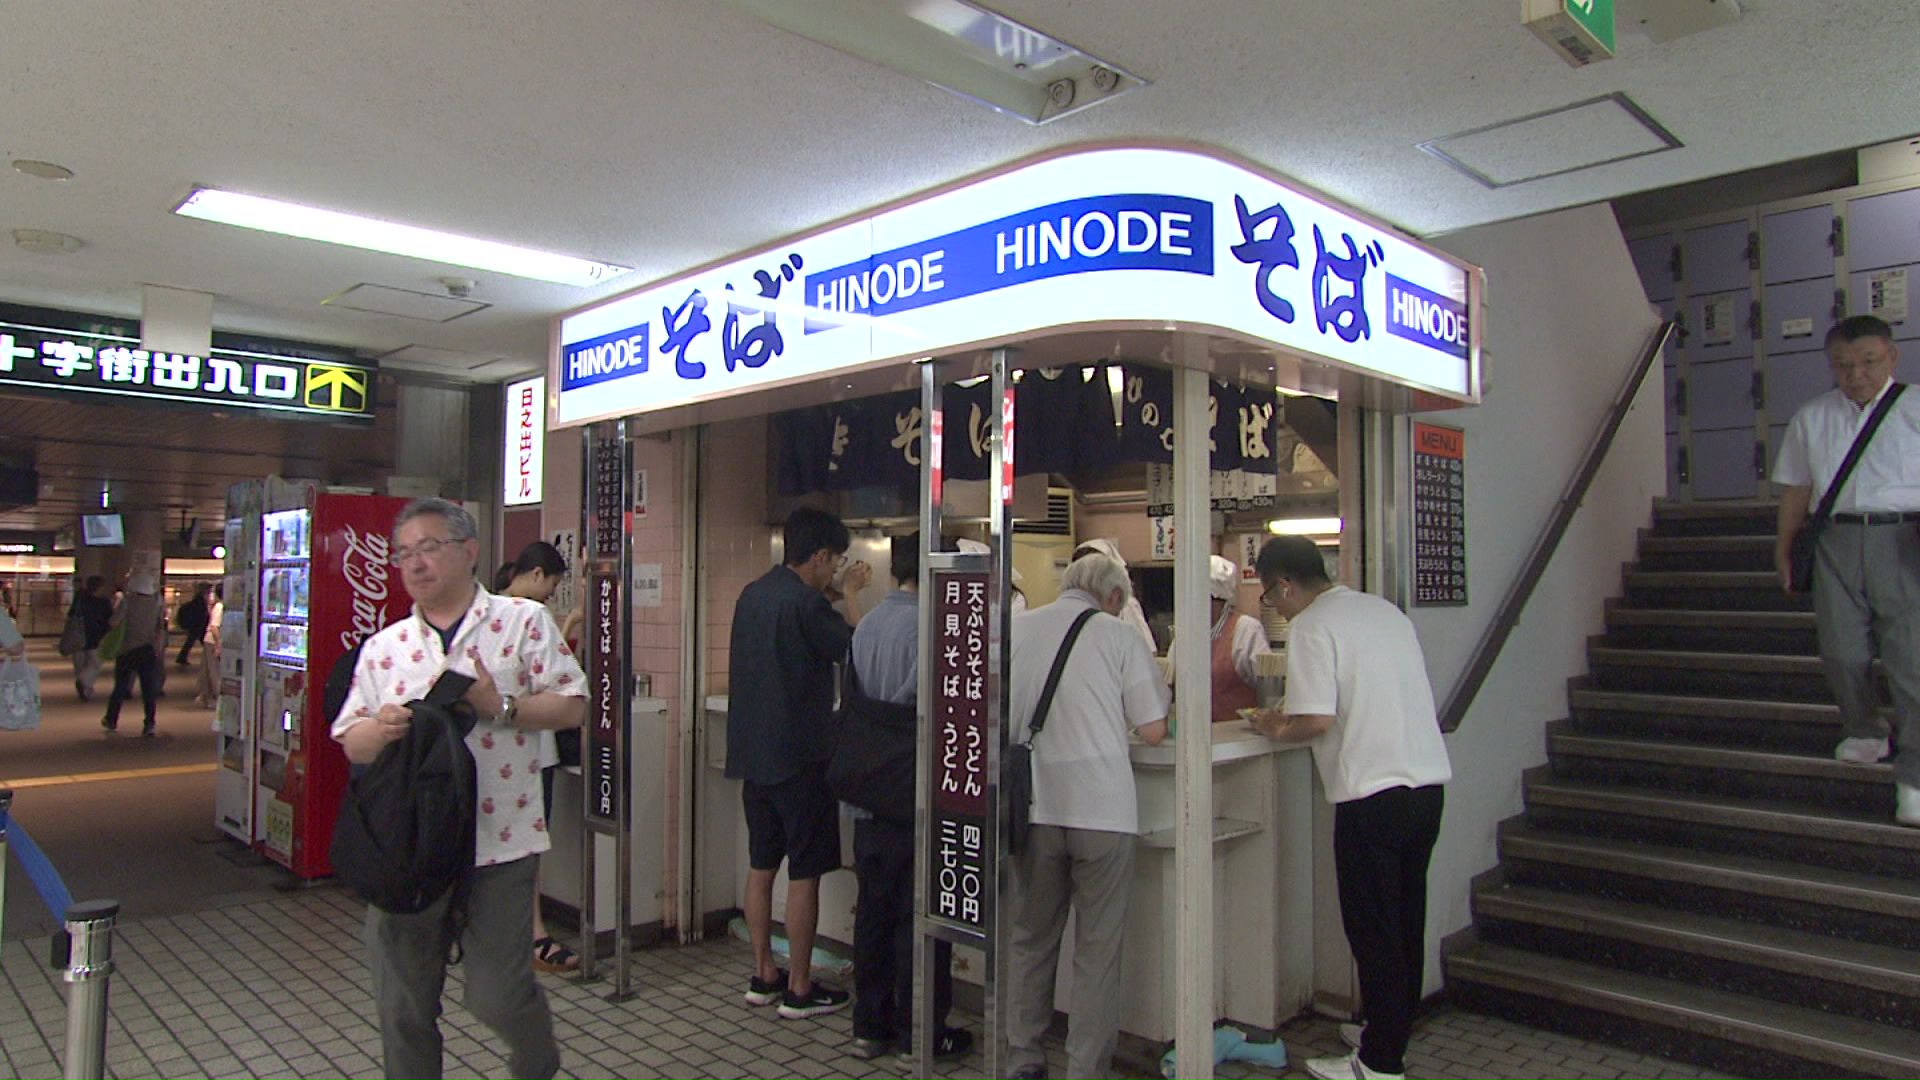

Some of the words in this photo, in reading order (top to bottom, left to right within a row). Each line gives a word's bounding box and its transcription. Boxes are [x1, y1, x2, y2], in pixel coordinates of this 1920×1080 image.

[569, 335, 643, 381] HINODE
[659, 253, 803, 379] そば
[816, 250, 945, 313] HINODE
[996, 210, 1193, 274] HINODE
[1230, 193, 1385, 343] そば
[1392, 287, 1469, 346] HINODE
[0, 334, 298, 399] 十字街出入口
[519, 387, 532, 498] 日之出ビル
[1422, 431, 1457, 452] MENU
[600, 578, 612, 730] かけそば・うどん
[942, 581, 961, 793] 月見そば・うどん
[964, 582, 985, 797] 天ぷらそば・うどん
[600, 746, 612, 815] 三二〇円
[939, 820, 957, 917] 三七〇円
[962, 824, 981, 923] 四二〇円
